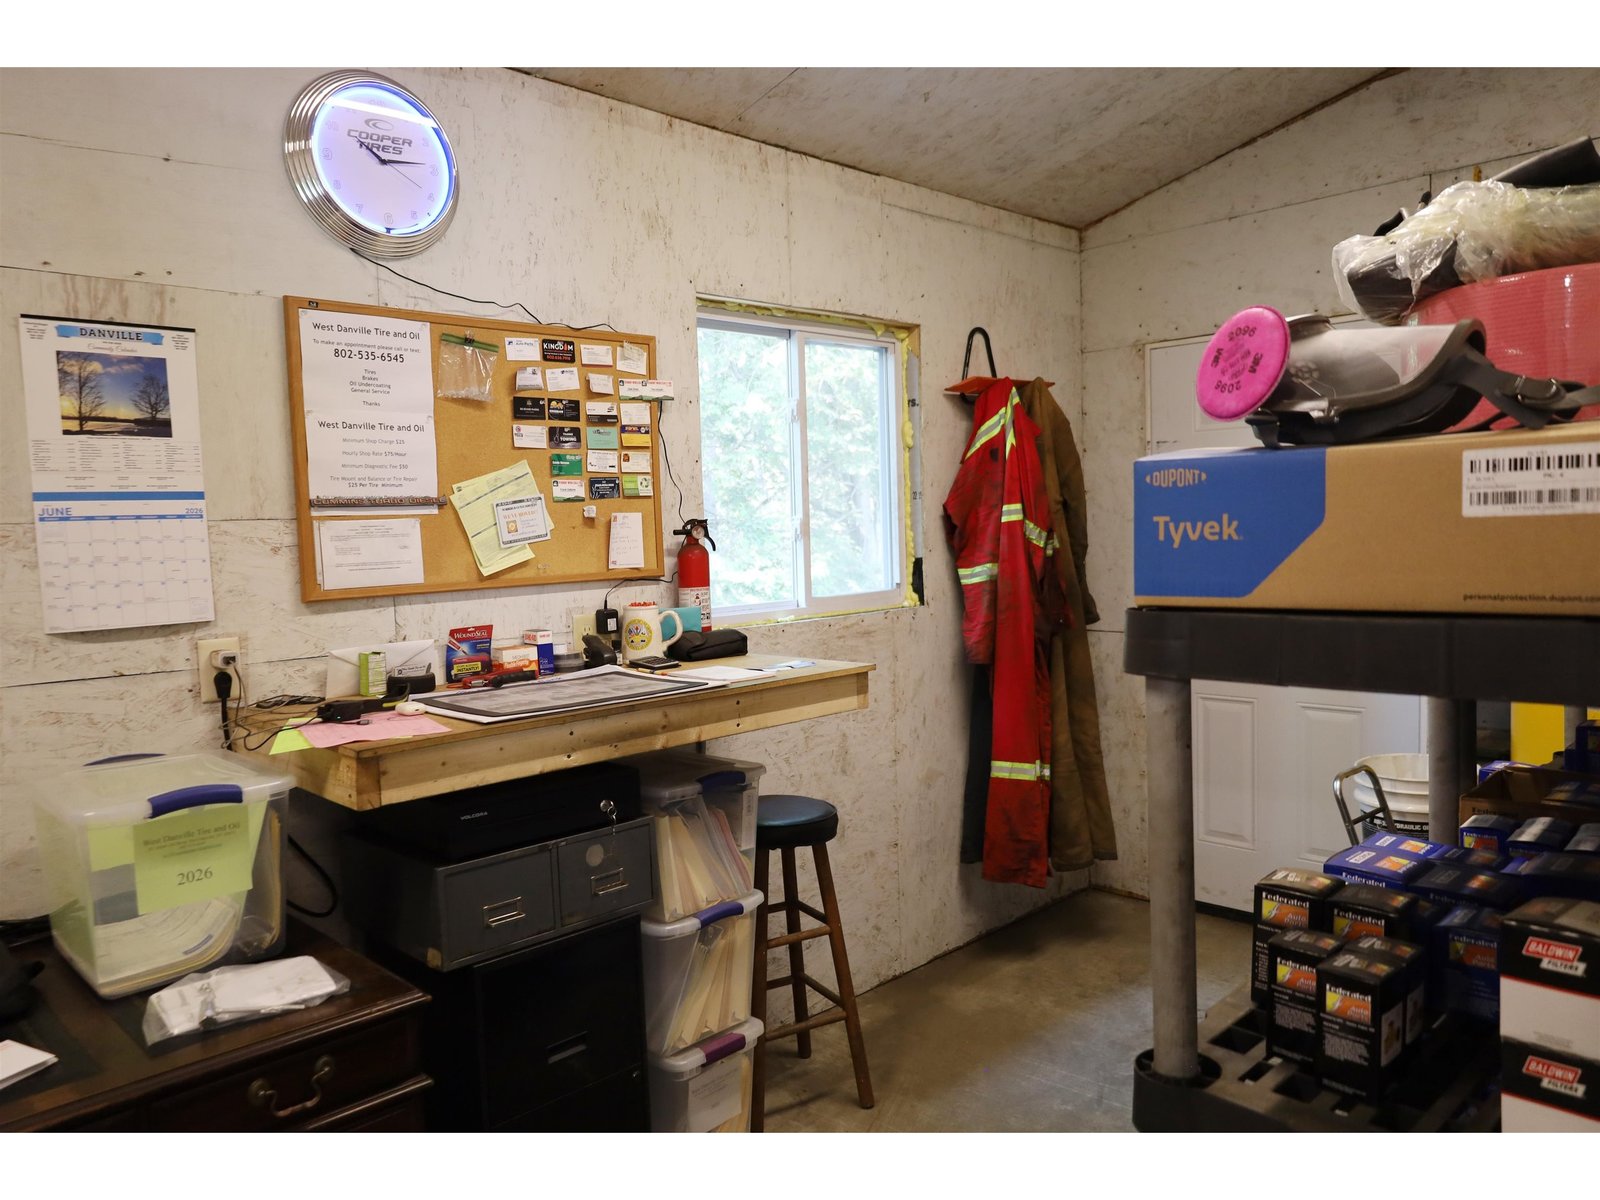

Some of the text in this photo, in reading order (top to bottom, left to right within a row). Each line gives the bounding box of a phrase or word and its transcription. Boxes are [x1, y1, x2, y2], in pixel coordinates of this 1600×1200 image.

[348, 129, 412, 147] COOPER
[357, 140, 403, 155] TIRES
[80, 328, 143, 341] DANVILLE
[312, 322, 420, 340] West Danville Tire and Oil
[1228, 325, 1257, 342] 2096
[334, 348, 404, 363] 802-535-6545
[318, 421, 339, 429] West
[342, 422, 376, 430] Danville
[378, 423, 394, 431] Tire
[397, 424, 412, 432] and
[1152, 468, 1200, 487] DUPONT
[38, 507, 72, 517] JUNE
[1153, 513, 1239, 549] Tyvek
[1394, 823, 1421, 831] DRAULIC
[177, 867, 213, 885] 2026
[1342, 872, 1386, 888] Federated
[1262, 892, 1309, 908] Federated
[1334, 908, 1385, 927] Federated
[1528, 941, 1577, 960] BALDWIN
[1326, 983, 1372, 1002] Federated
[1528, 1061, 1577, 1082] BALDWIN
